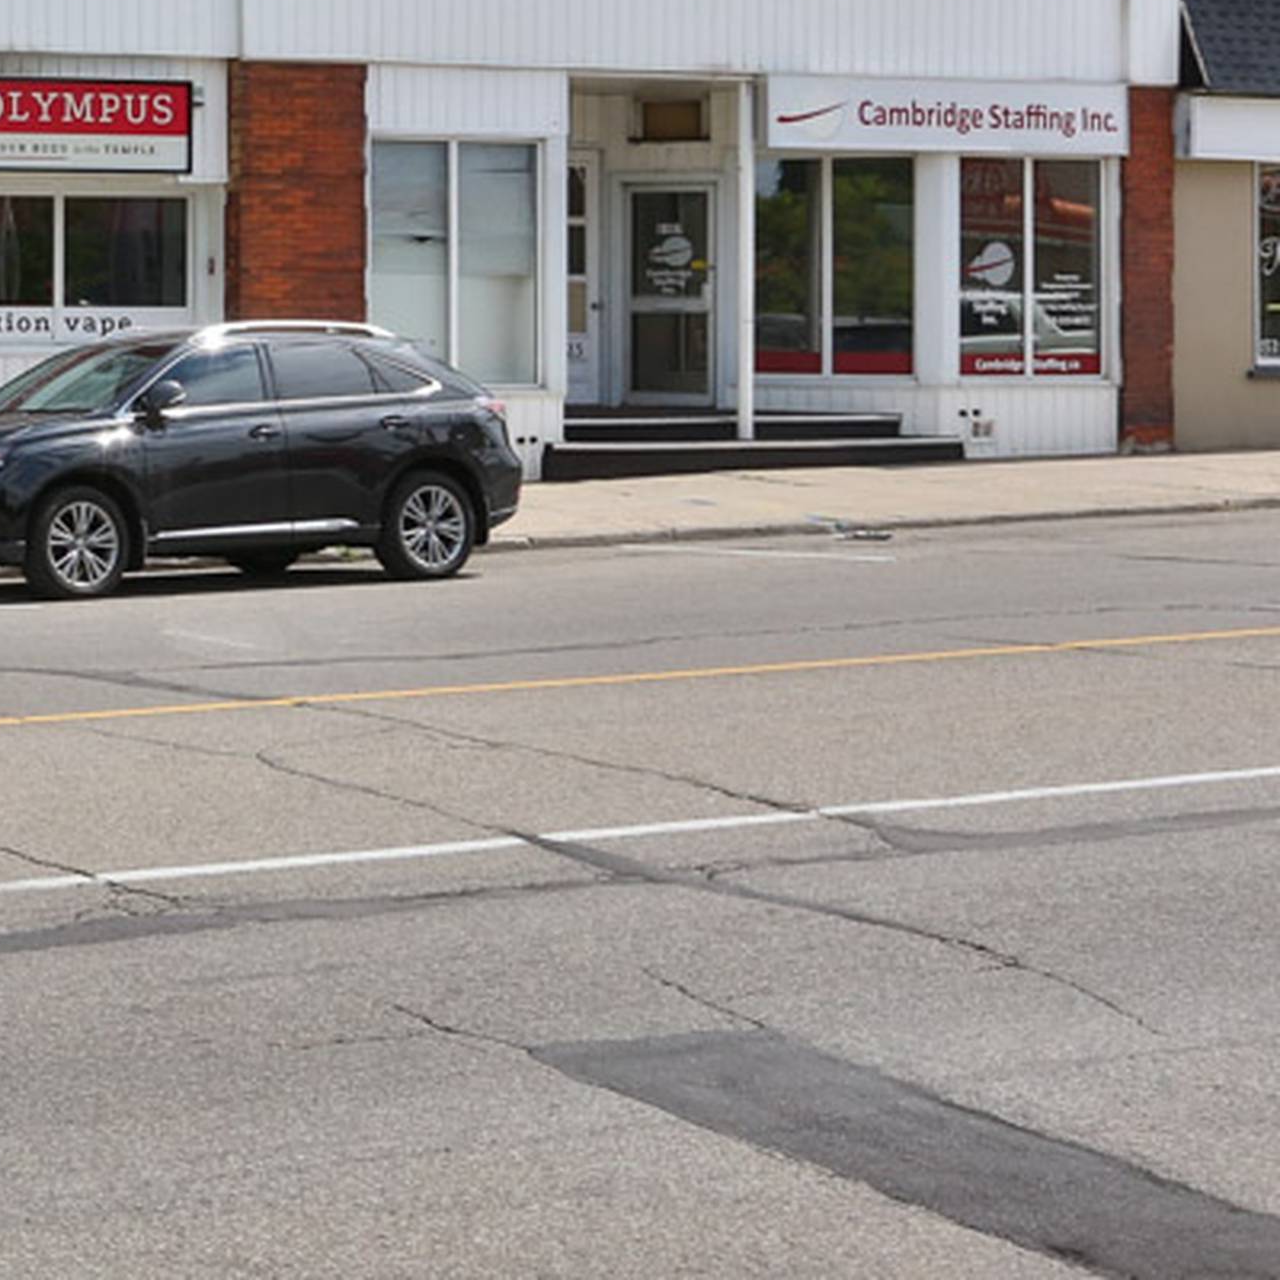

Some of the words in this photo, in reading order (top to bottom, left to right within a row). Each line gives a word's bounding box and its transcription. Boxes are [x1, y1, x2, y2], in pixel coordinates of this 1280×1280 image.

[857, 100, 984, 135] Cambridge
[988, 104, 1077, 138] Staffing
[1081, 107, 1119, 133] Inc.
[64, 317, 133, 336] vape
